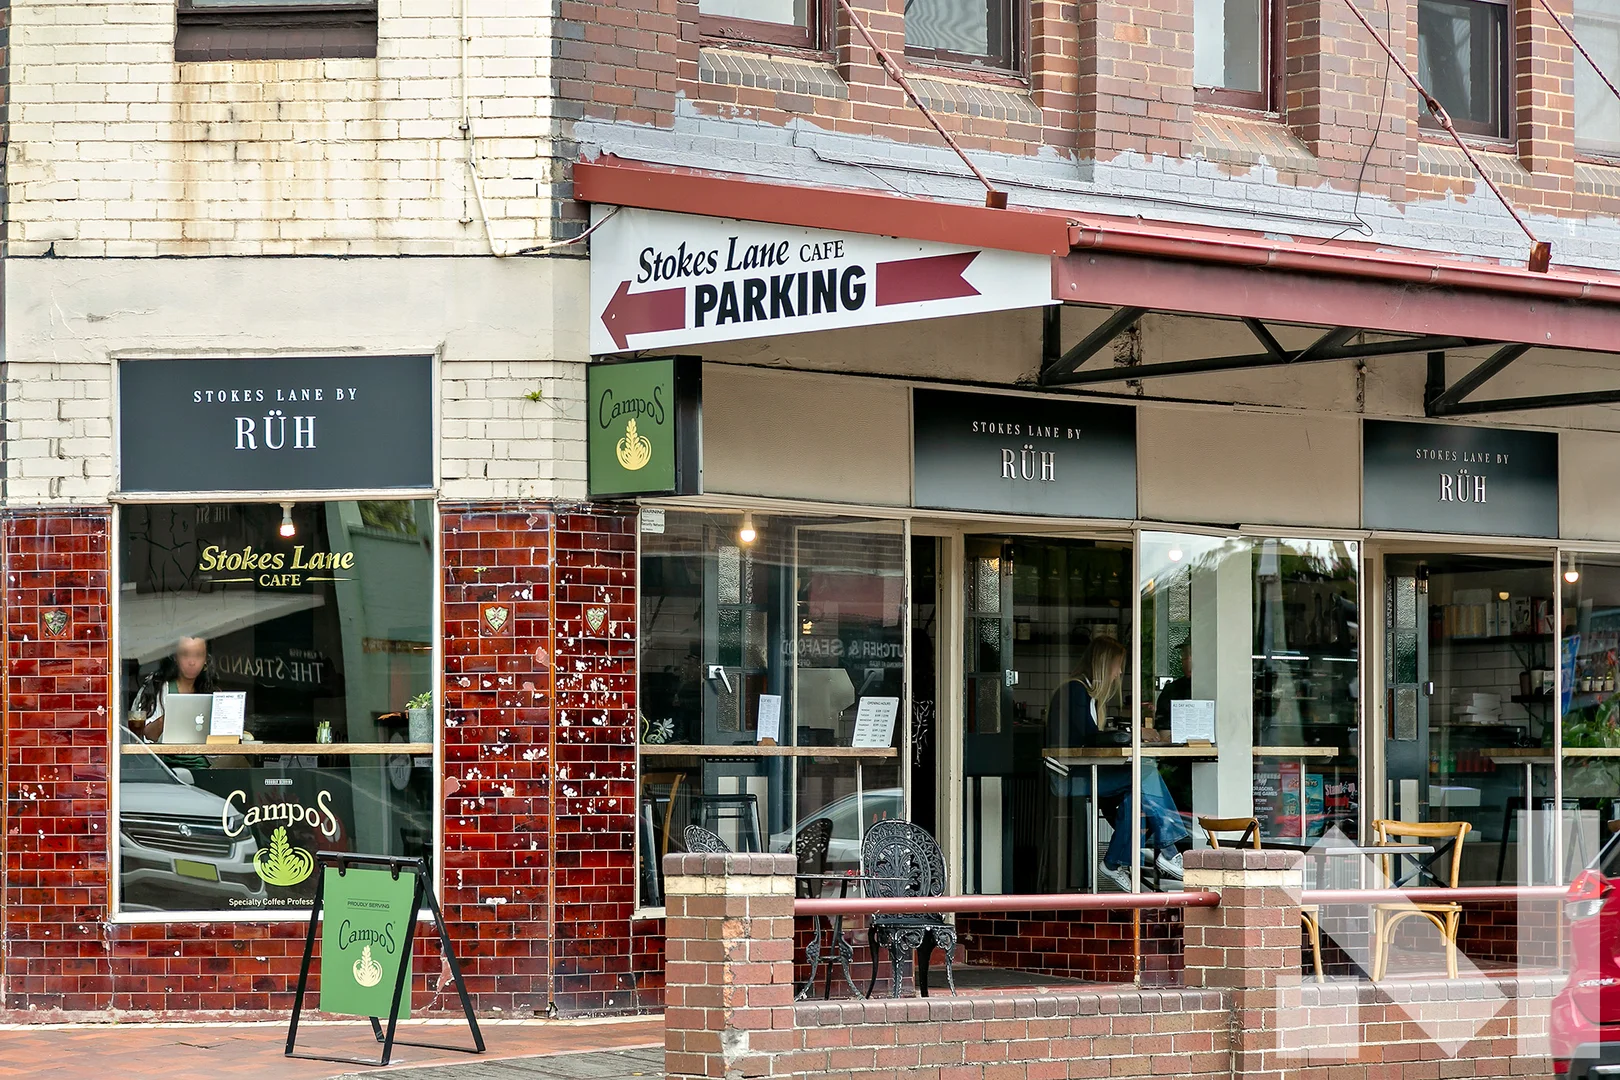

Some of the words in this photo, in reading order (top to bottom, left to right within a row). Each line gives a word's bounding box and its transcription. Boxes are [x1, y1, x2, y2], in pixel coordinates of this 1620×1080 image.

[637, 241, 718, 284] Stokes
[725, 236, 790, 272] Lane
[799, 239, 845, 263] CAFE
[694, 264, 867, 328] PARKING
[193, 388, 265, 403] STOKES
[276, 388, 323, 402] LANE
[336, 388, 358, 401] BY
[234, 409, 317, 450] RÜH
[972, 420, 1021, 437] STOKES
[1028, 425, 1061, 438] LANE
[1067, 428, 1082, 441] BY
[1000, 444, 1057, 483] RÜH
[1416, 448, 1458, 462] STOKES
[1463, 451, 1494, 464] LANE
[1496, 453, 1510, 465] BY
[1438, 468, 1488, 503] RÜH
[200, 545, 284, 571] Stokes
[290, 545, 356, 570] Lane
[259, 574, 302, 587] CAFE
[228, 898, 261, 907] Specialty
[262, 898, 286, 906] Coffee
[287, 898, 315, 906] Profess
[347, 900, 368, 908] PROUDLY
